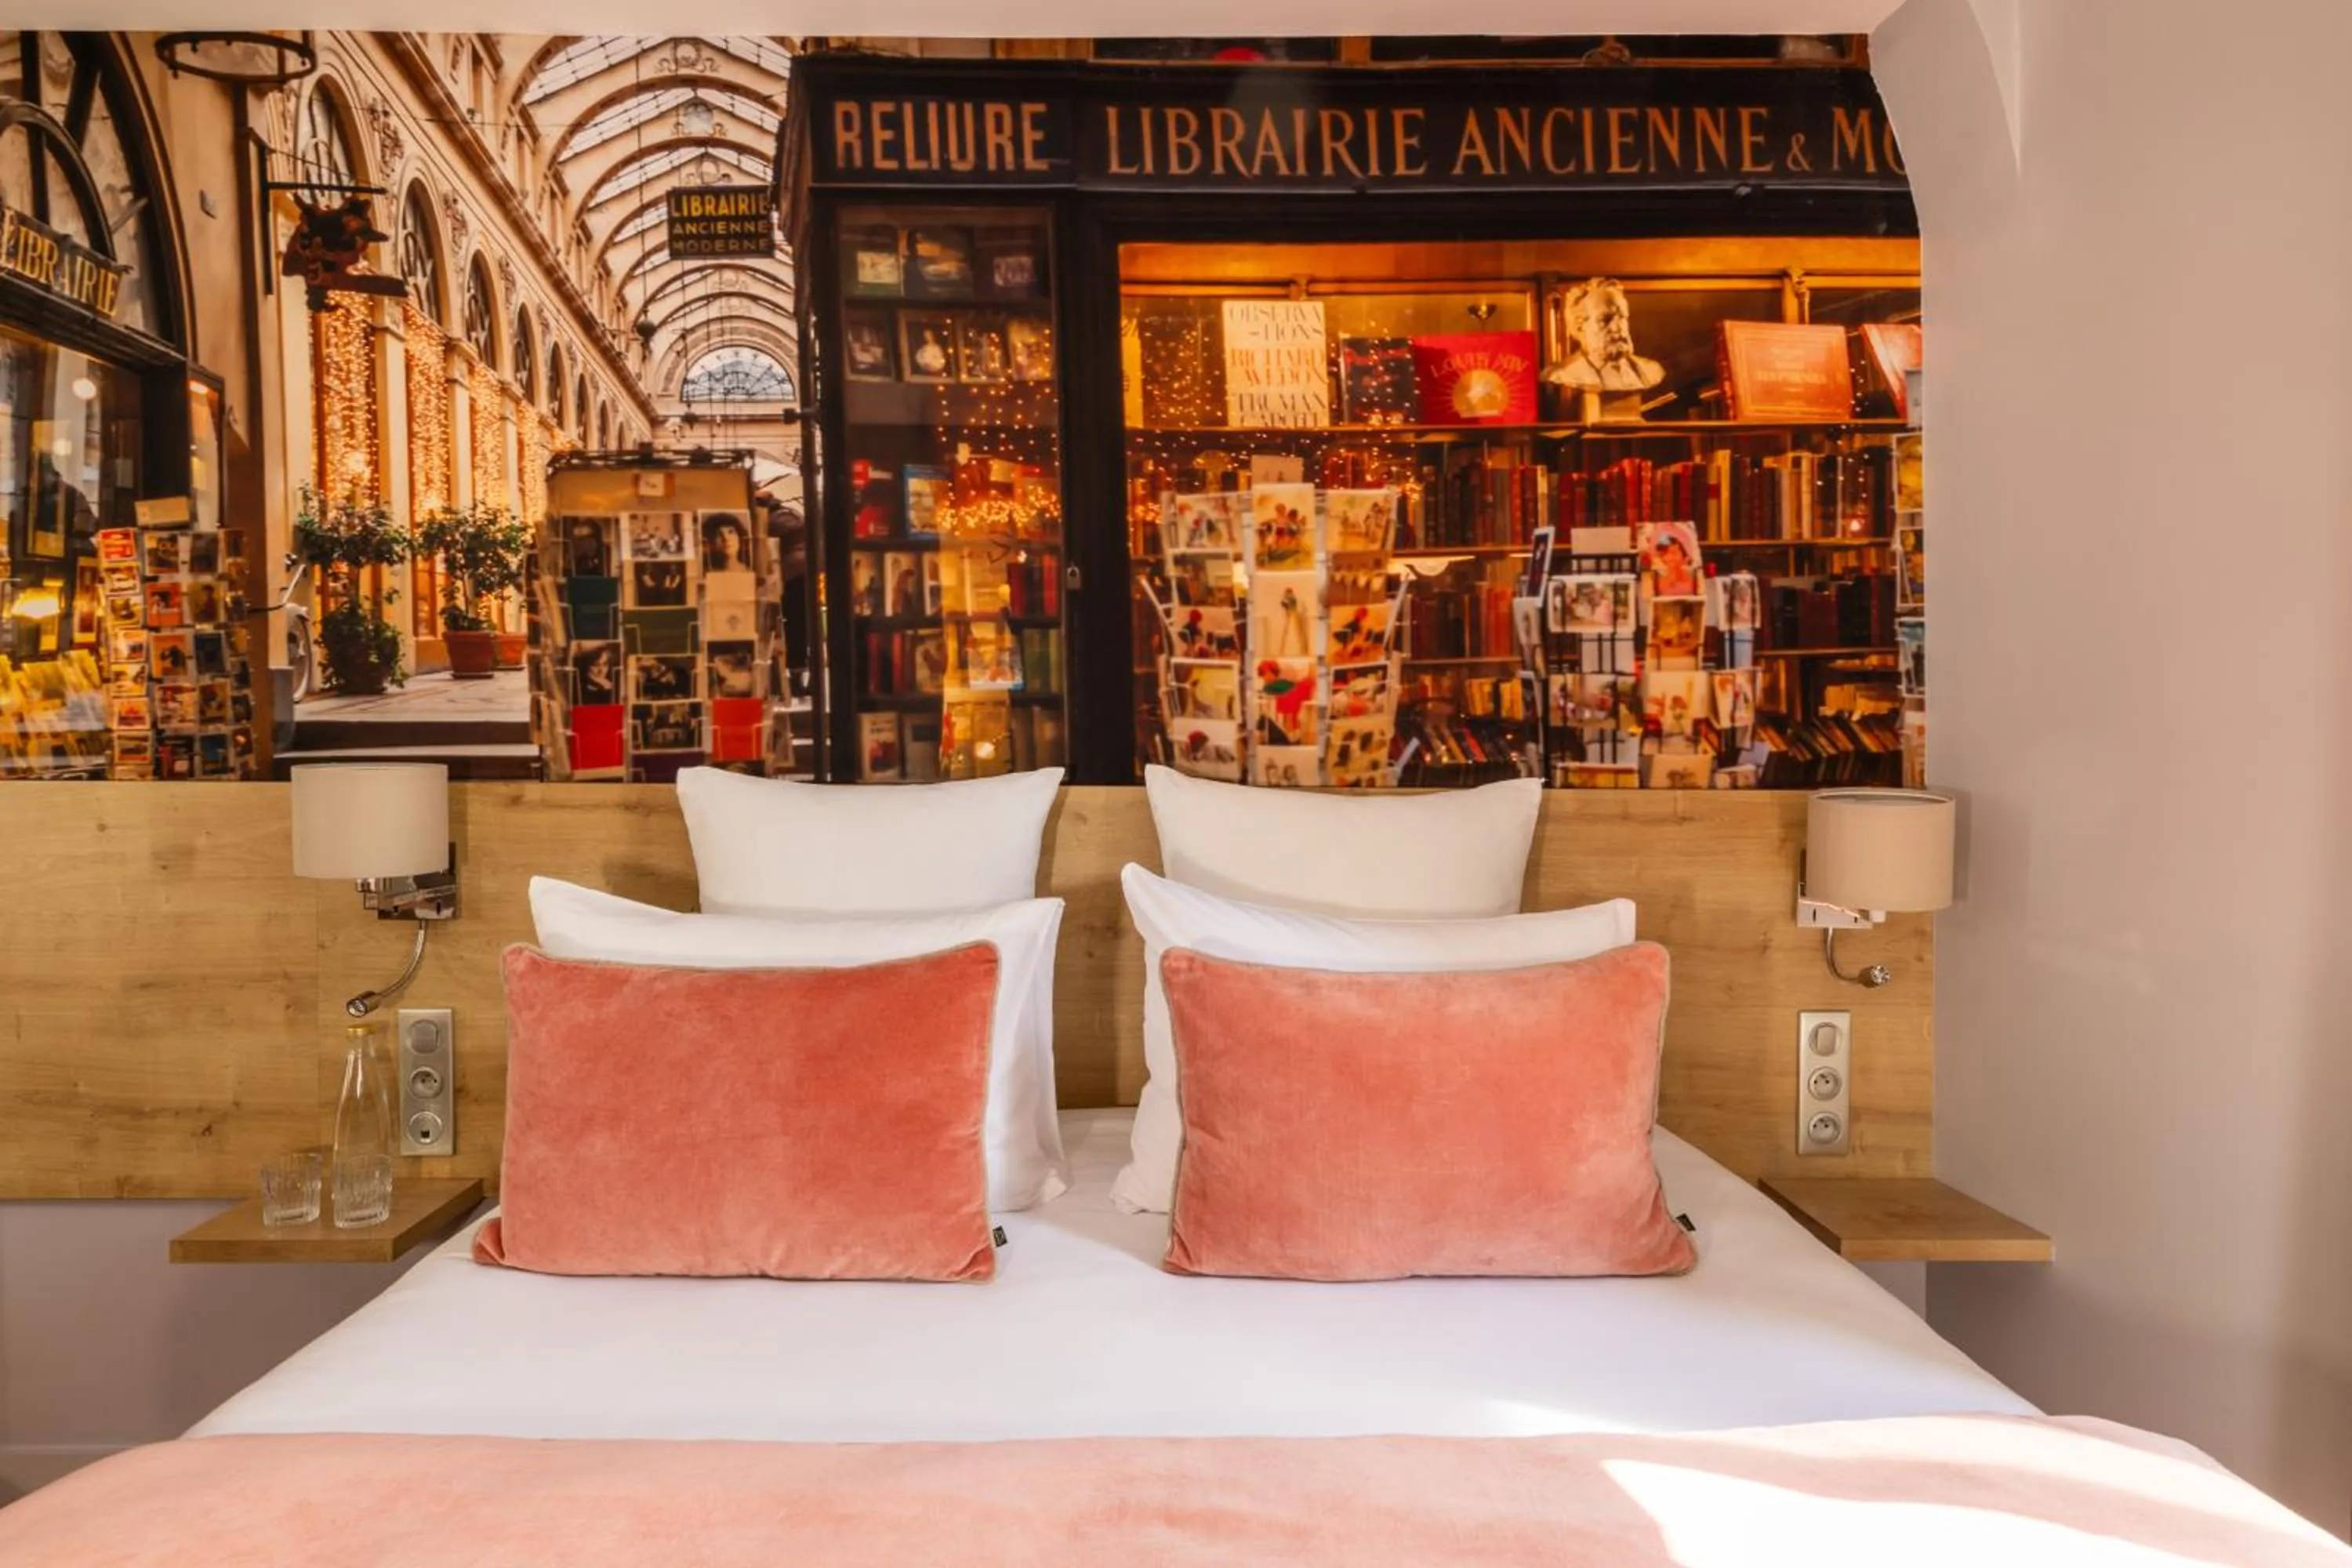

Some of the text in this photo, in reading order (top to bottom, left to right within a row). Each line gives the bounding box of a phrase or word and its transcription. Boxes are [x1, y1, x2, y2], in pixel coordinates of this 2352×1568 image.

[834, 100, 1050, 172] RELIURE
[1105, 105, 1428, 178] LIBRAIRIE
[1450, 107, 1773, 176] ANCIENNE
[1784, 132, 1813, 172] &
[671, 193, 770, 217] LIBRAIRIE
[672, 220, 770, 235] ANCIENNE
[0, 208, 121, 318] LIBRAIRIE
[672, 238, 770, 253] MODERNE
